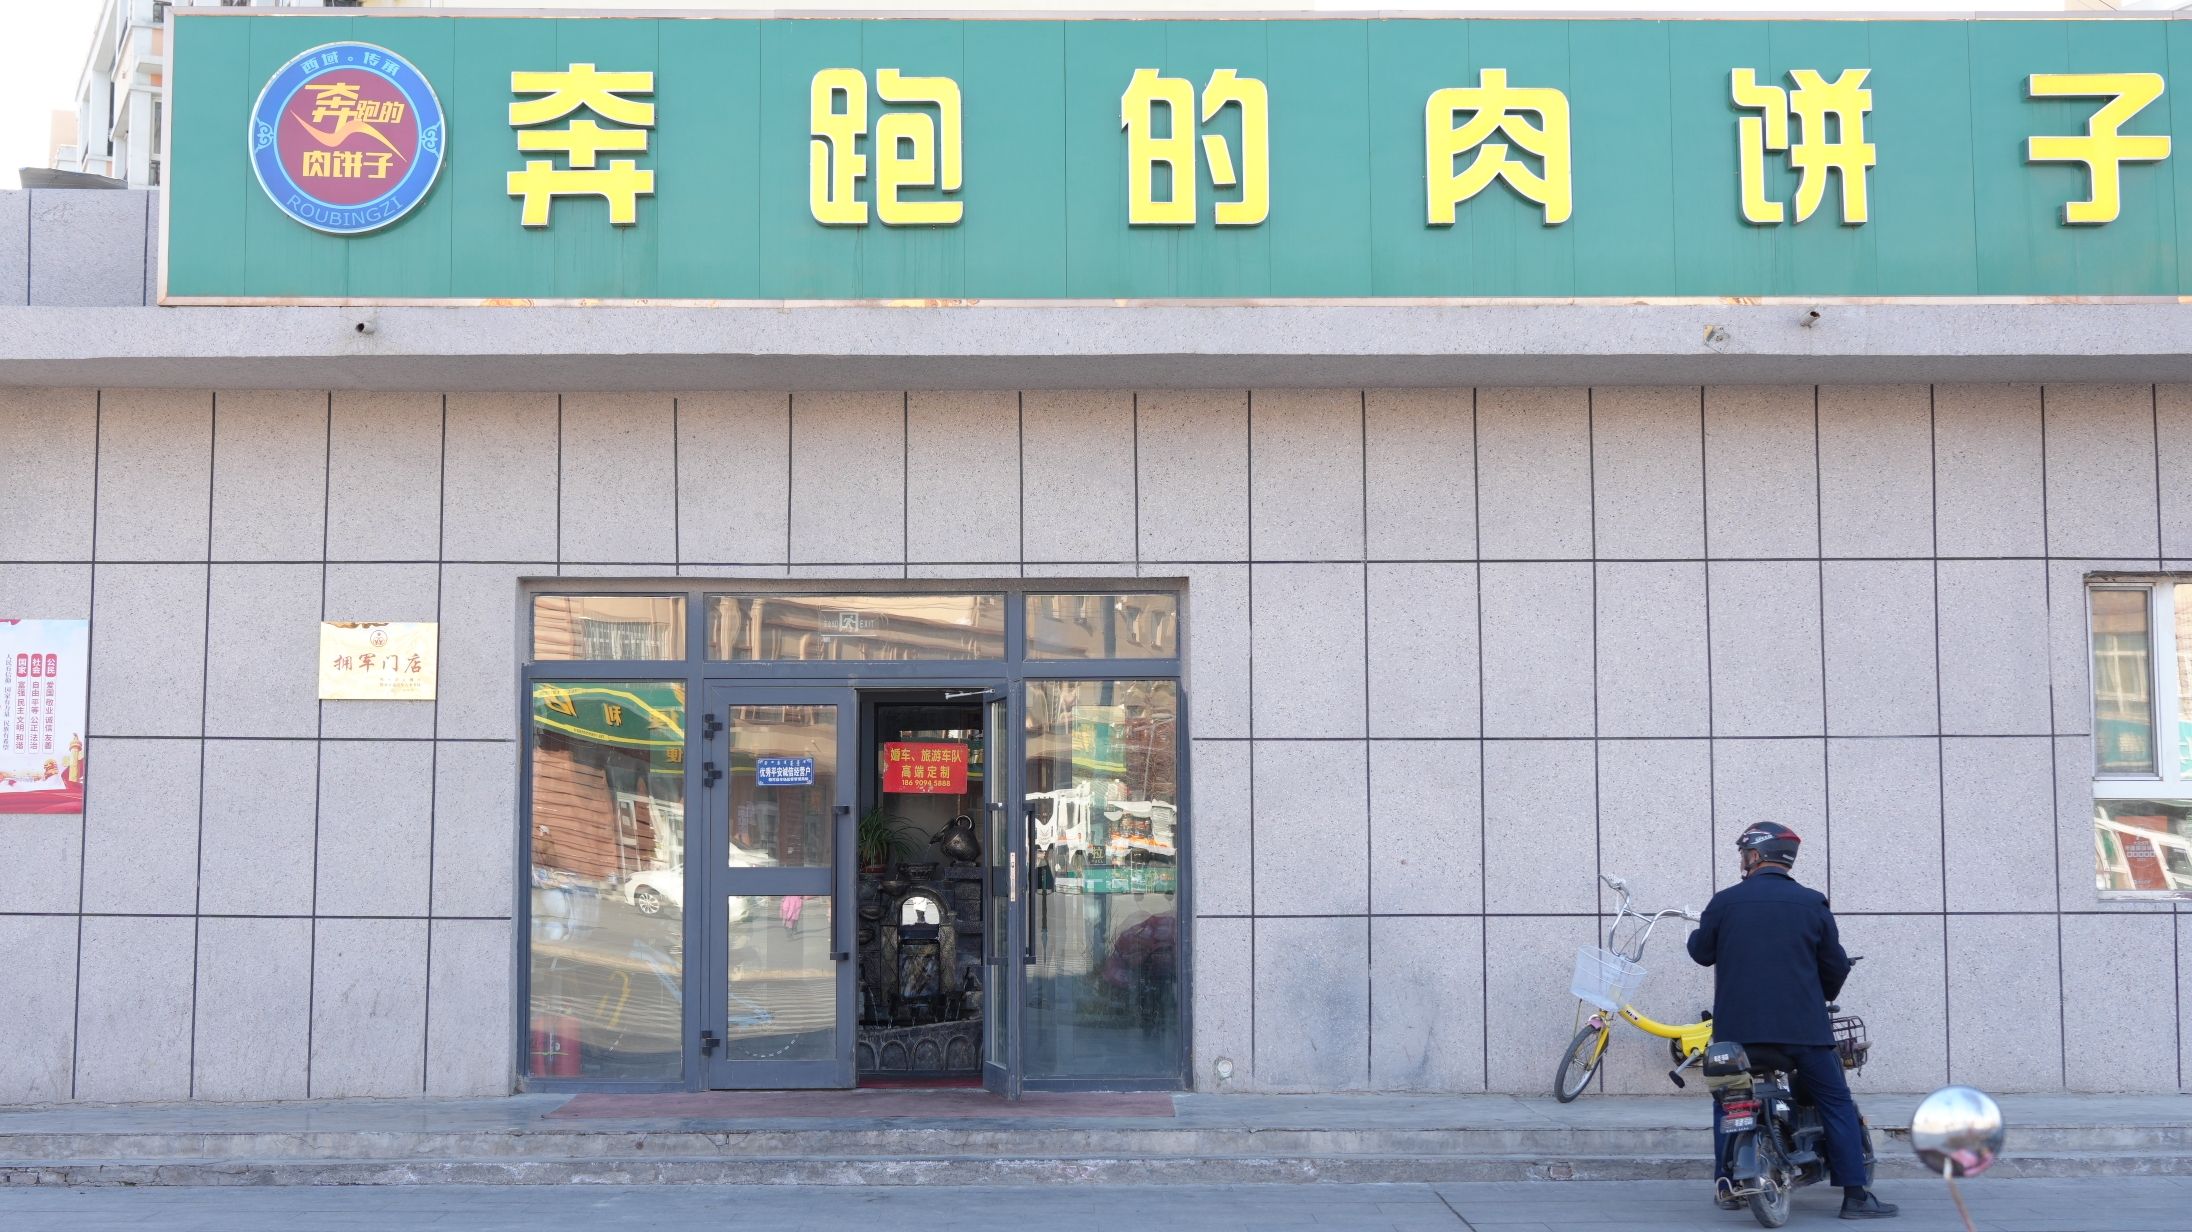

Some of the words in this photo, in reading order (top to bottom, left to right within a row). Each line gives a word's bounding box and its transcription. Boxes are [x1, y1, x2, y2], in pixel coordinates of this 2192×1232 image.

[507, 62, 2173, 228] 奔跑的肉饼子
[302, 150, 393, 179] 肉饼子
[286, 194, 405, 226] ROUBINGZI
[18, 658, 27, 674] 国家
[32, 658, 41, 674] 社会
[47, 658, 56, 674] 公民
[333, 652, 422, 673] 拥军门店
[17, 681, 25, 696] 富强
[32, 681, 40, 696] 自由
[46, 681, 54, 696] 爱国
[17, 698, 25, 715] 民主
[31, 698, 39, 715] 平等
[45, 698, 54, 715] 敬业
[16, 716, 25, 731] 文明
[30, 716, 39, 731] 公正
[45, 716, 53, 732] 诚信
[15, 733, 24, 750] 和谐
[30, 733, 38, 750] 法治
[890, 748, 962, 762] 婚车、旅游车队
[901, 764, 950, 779] 高端定制
[914, 779, 932, 787] 9094
